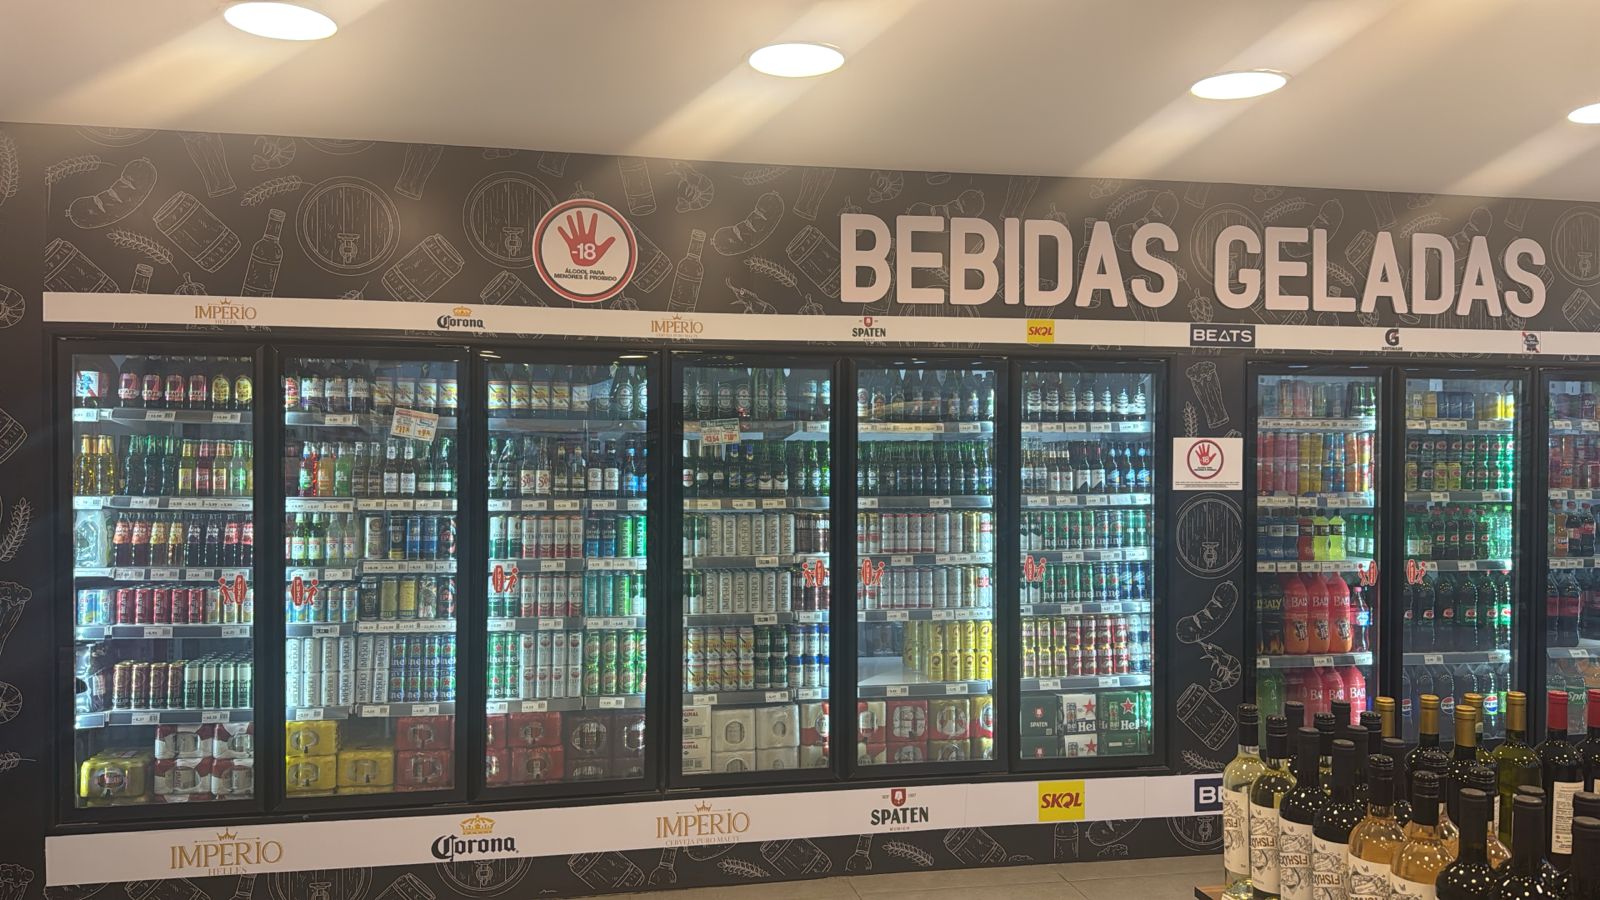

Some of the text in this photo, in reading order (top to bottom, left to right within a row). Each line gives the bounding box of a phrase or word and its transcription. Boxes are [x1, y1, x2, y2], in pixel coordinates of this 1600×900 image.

[571, 242, 597, 260] -18
[564, 267, 587, 275] ÁLCOOL
[840, 213, 1546, 318] BEBIDAS GELADAS
[553, 272, 583, 280] MENORES
[589, 274, 618, 282] PROIBIDO
[437, 315, 486, 330] Corona
[852, 327, 887, 338] SPATEN
[1028, 325, 1055, 338] SKOL
[1193, 328, 1253, 344] BEATS
[1041, 792, 1082, 809] SKOL
[870, 806, 929, 826] SPATEN
[431, 834, 519, 862] Corona
